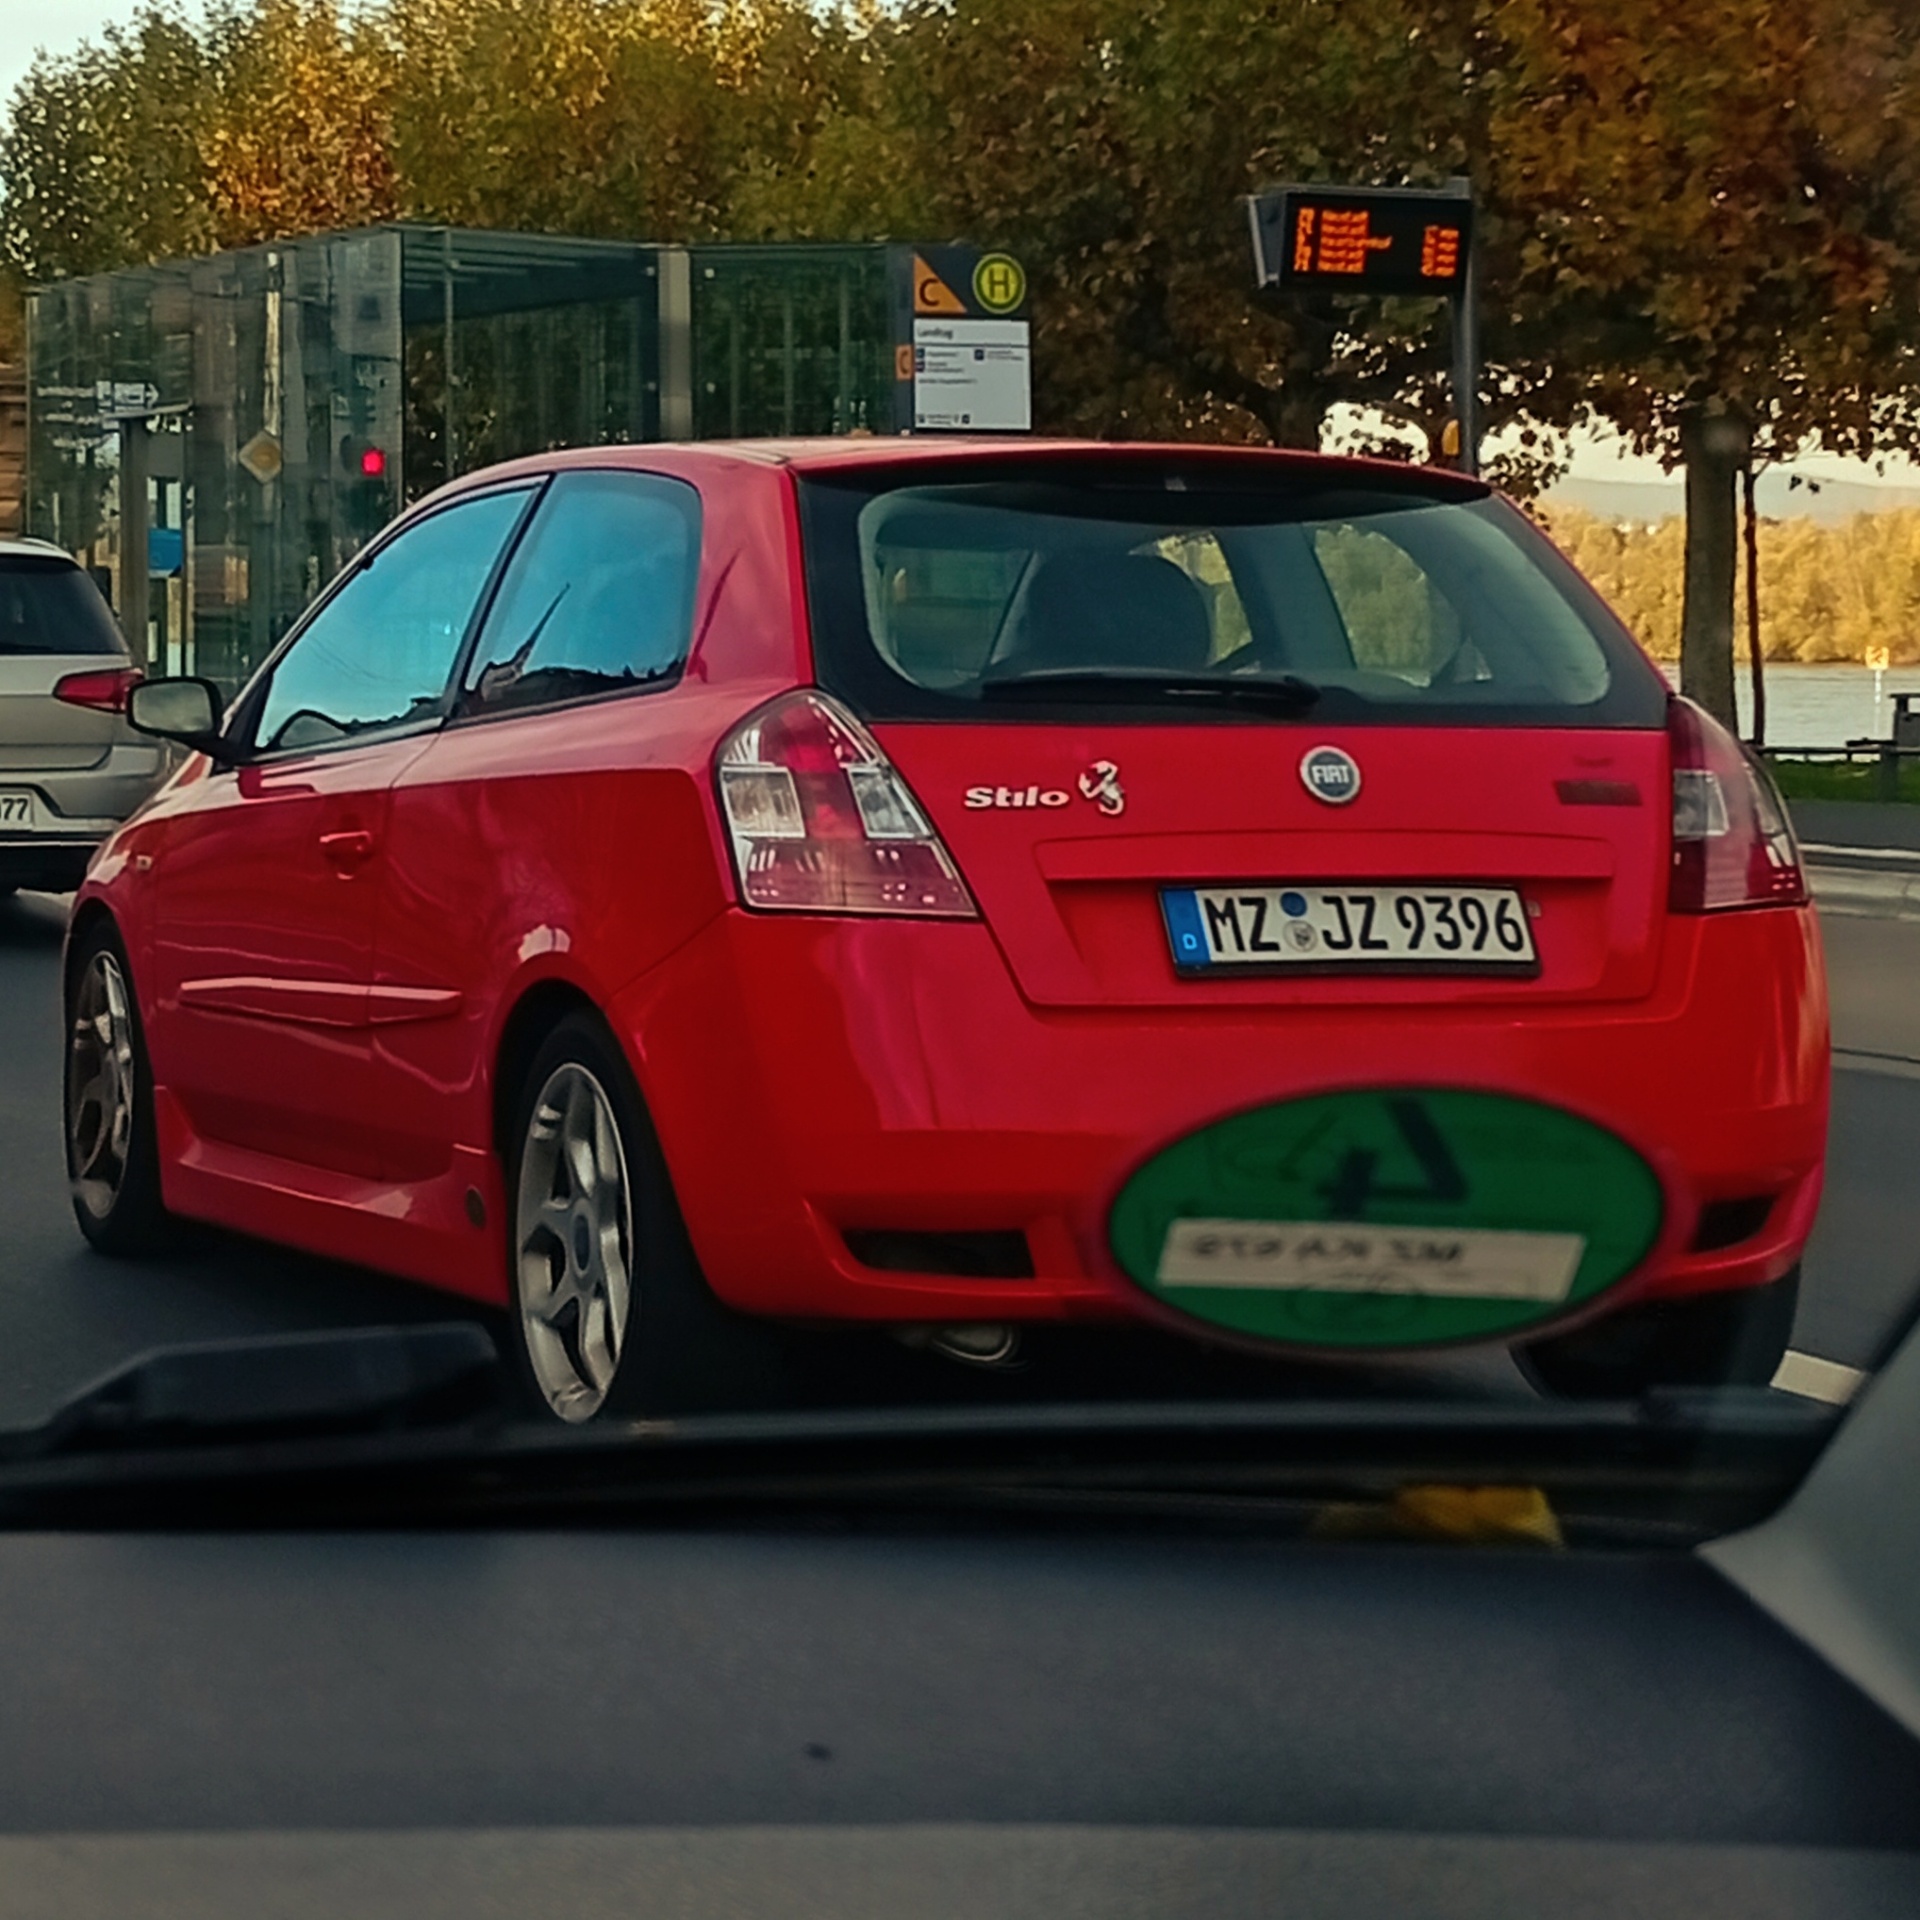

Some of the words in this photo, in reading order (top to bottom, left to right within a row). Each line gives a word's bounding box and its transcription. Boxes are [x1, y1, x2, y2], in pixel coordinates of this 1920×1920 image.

[919, 278, 939, 306] C
[989, 268, 1010, 299] H
[1311, 763, 1352, 785] FIAT
[0, 798, 28, 821] 77
[964, 786, 1070, 809] Stilo
[1182, 933, 1198, 949] D
[1203, 896, 1280, 953] MZ
[1321, 896, 1389, 951] JZ
[1394, 896, 1524, 951] 9396
